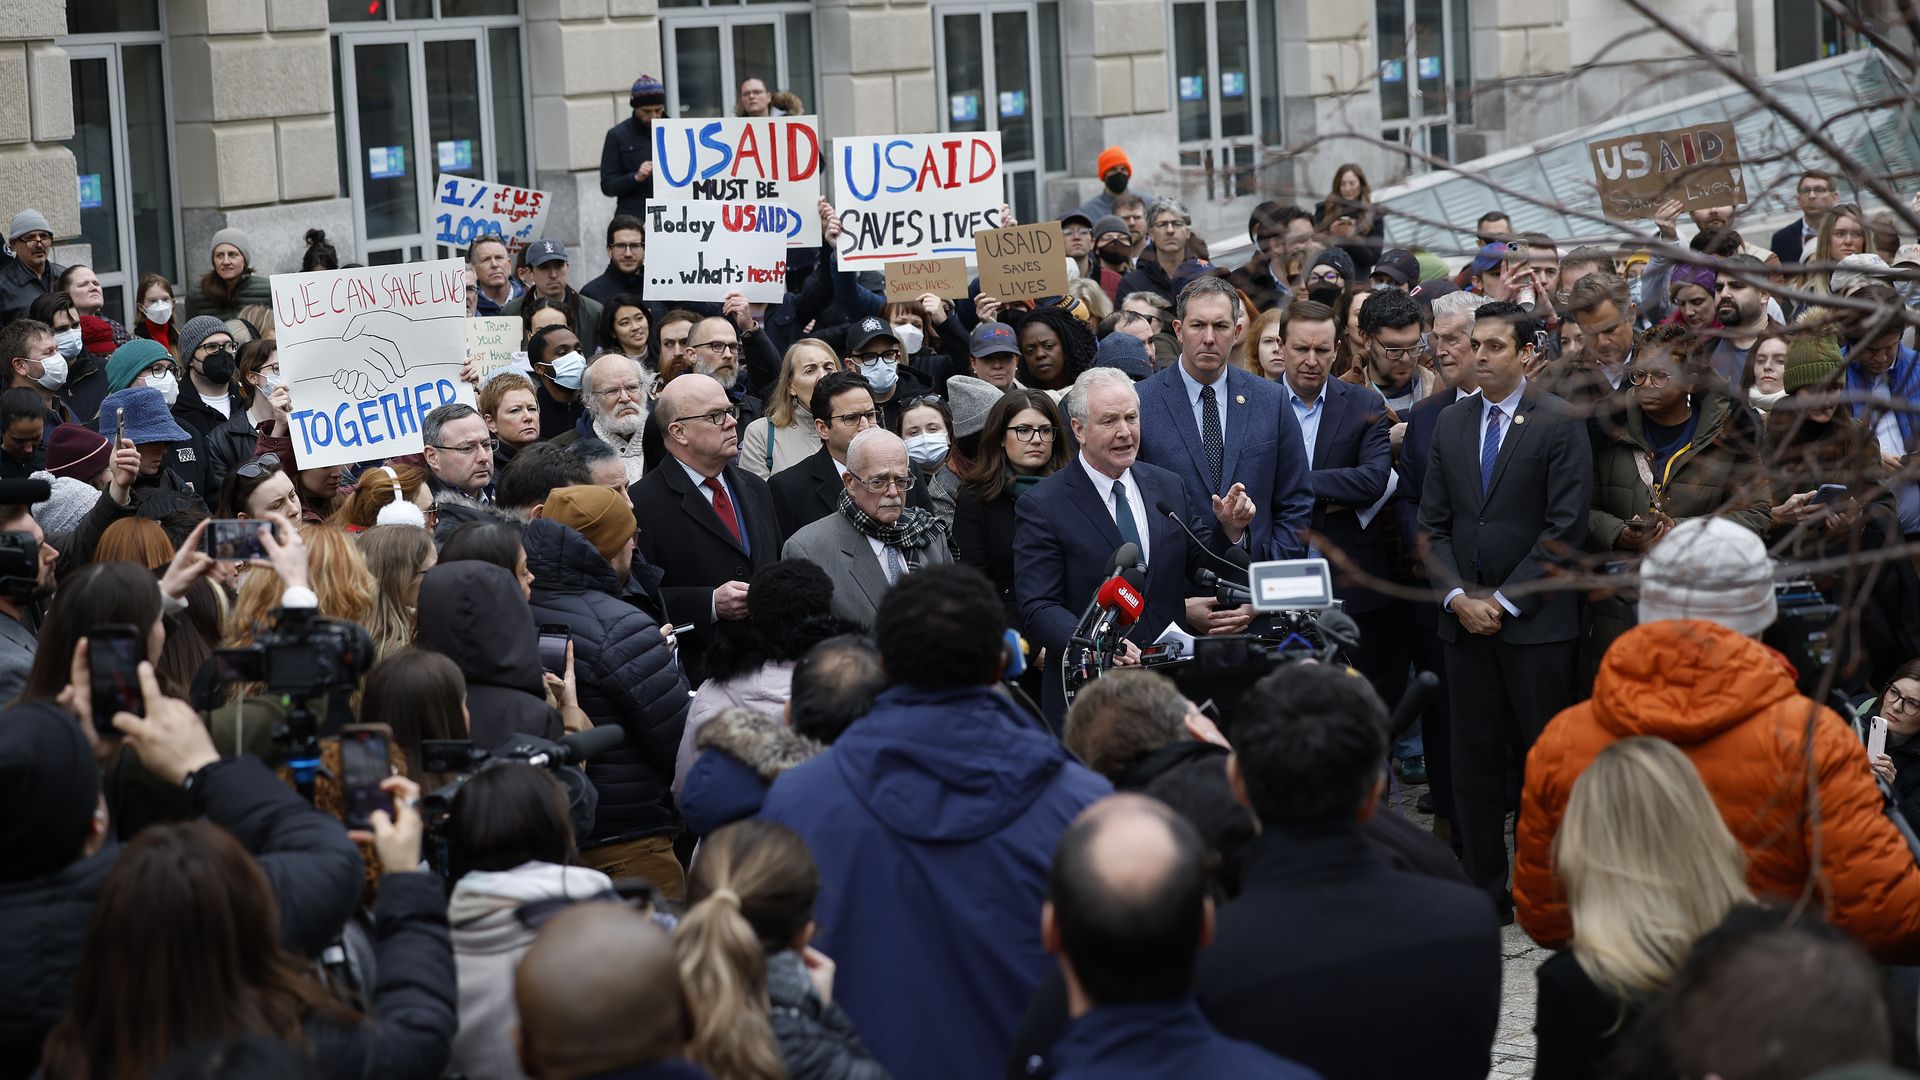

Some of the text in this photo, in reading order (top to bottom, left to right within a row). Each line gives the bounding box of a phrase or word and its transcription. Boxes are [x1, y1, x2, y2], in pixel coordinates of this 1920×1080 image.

[655, 121, 819, 188] USAID
[844, 138, 996, 202] USAID
[494, 187, 511, 202] of
[692, 178, 779, 200] MUST BE
[492, 201, 539, 223] budget
[647, 205, 715, 242] Today
[721, 204, 788, 234] USAID
[516, 224, 533, 238] of
[839, 209, 924, 256] SAVES
[984, 230, 1052, 258] USAID
[747, 260, 787, 285] next?
[902, 260, 942, 276] USAID
[1002, 261, 1042, 274] SAVES
[890, 279, 922, 294] Saves
[1000, 279, 1047, 297] LIVES
[275, 269, 466, 327] WE CAN SAVE LIVES
[477, 335, 503, 346] YOUR
